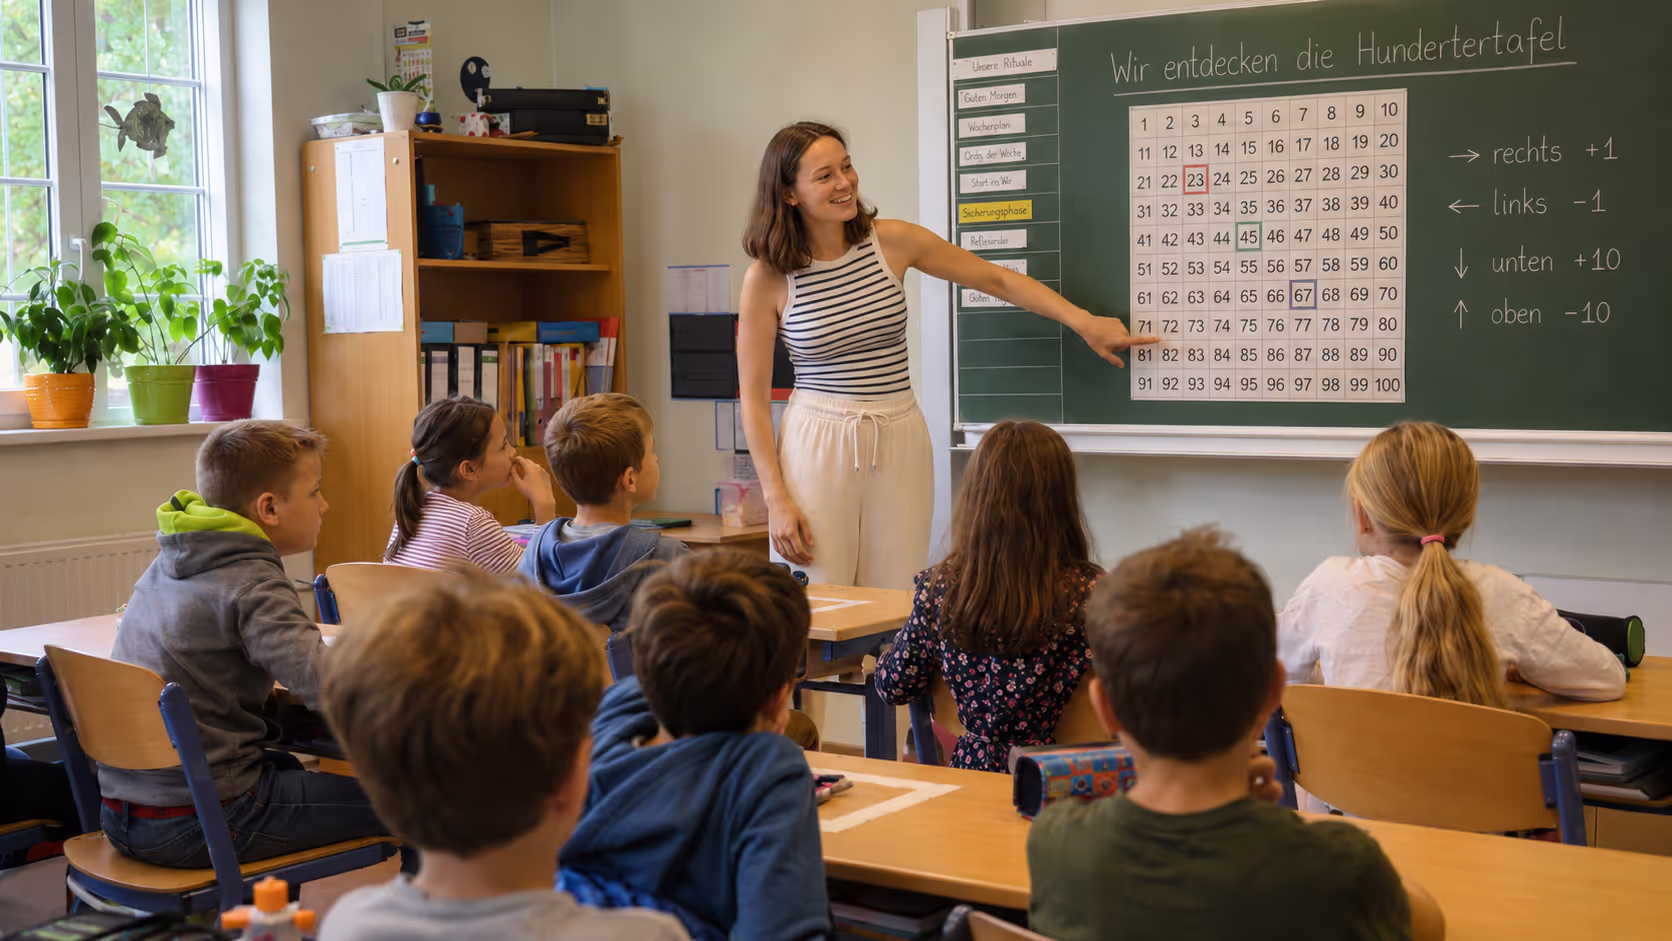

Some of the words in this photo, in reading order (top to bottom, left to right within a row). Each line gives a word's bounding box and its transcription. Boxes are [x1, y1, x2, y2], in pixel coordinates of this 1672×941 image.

[1110, 51, 1150, 83] Wir
[1164, 41, 1278, 80] entdecken
[1297, 37, 1335, 70] die
[1358, 15, 1567, 66] Hundertertafel
[972, 60, 998, 72] Unsere
[1003, 56, 1032, 68] Rituale
[964, 92, 986, 103] Guten
[989, 90, 1017, 103] Morgen
[1141, 118, 1146, 131] 1
[1166, 116, 1174, 130] 2
[1192, 114, 1200, 128] 3
[1217, 113, 1226, 126] 4
[1245, 111, 1253, 125] 5
[1271, 109, 1280, 124] 6
[1299, 107, 1308, 122] 7
[1327, 106, 1336, 120] 8
[1355, 104, 1365, 119] 9
[1381, 102, 1398, 117] 10
[986, 149, 997, 159] der
[1138, 147, 1150, 160] 11
[1163, 145, 1177, 159] 12
[1188, 143, 1203, 158] 13
[1215, 142, 1230, 156] 14
[1241, 140, 1257, 155] 15
[1268, 139, 1284, 154] 16
[1295, 137, 1312, 152] 17
[1323, 136, 1340, 151] 18
[1352, 134, 1368, 149] 19
[1380, 133, 1399, 148] 20
[1494, 135, 1561, 164] rechts
[1586, 137, 1618, 159] +1
[971, 177, 988, 188] Start
[1000, 175, 1012, 185] Wir
[1137, 176, 1151, 190] 21
[1161, 174, 1178, 189] 22
[1187, 173, 1204, 187] 23
[1213, 172, 1231, 186] 24
[1240, 170, 1258, 185] 25
[1267, 169, 1285, 184] 26
[1294, 168, 1312, 183] 27
[1322, 166, 1340, 181] 28
[1350, 165, 1369, 180] 29
[1379, 164, 1398, 179] 30
[962, 203, 1027, 219] Sicherungsphase
[1137, 204, 1151, 219] 31
[1161, 203, 1178, 218] 32
[1187, 202, 1204, 217] 33
[1213, 201, 1231, 216] 34
[1240, 200, 1258, 215] 35
[1267, 199, 1285, 214] 36
[1294, 198, 1312, 213] 37
[1322, 197, 1340, 212] 38
[1350, 196, 1369, 211] 39
[1379, 195, 1398, 209] 40
[1494, 187, 1547, 215] links
[1137, 234, 1151, 247] 41
[1161, 232, 1178, 247] 42
[1187, 232, 1204, 246] 43
[1213, 231, 1231, 245] 44
[1239, 230, 1258, 244] 45
[1266, 229, 1285, 243] 46
[1294, 228, 1312, 243] 47
[1321, 227, 1340, 242] 48
[1350, 226, 1369, 241] 49
[1379, 225, 1398, 240] 50
[1137, 262, 1151, 276] 51
[1162, 262, 1179, 276] 52
[1187, 261, 1205, 275] 53
[1214, 261, 1231, 275] 54
[1240, 260, 1258, 274] 55
[1267, 259, 1285, 273] 56
[1294, 258, 1312, 273] 57
[1322, 257, 1340, 272] 58
[1350, 257, 1369, 272] 59
[1379, 256, 1398, 271] 60
[1493, 245, 1553, 272] unten
[1574, 248, 1620, 270] +10
[1137, 291, 1151, 305] 61
[1162, 290, 1178, 305] 62
[1187, 290, 1205, 304] 63
[1213, 290, 1231, 304] 64
[1240, 289, 1258, 303] 65
[1267, 289, 1285, 303] 66
[1294, 288, 1313, 303] 67
[1322, 287, 1340, 302] 68
[1350, 287, 1369, 301] 69
[1379, 286, 1398, 301] 70
[1491, 298, 1542, 324] oben
[1138, 320, 1152, 333] 71
[1162, 319, 1179, 333] 72
[1188, 319, 1205, 333] 73
[1214, 319, 1231, 332] 74
[1240, 318, 1257, 333] 75
[1267, 318, 1285, 332] 76
[1294, 318, 1312, 332] 77
[1322, 317, 1340, 332] 78
[1350, 317, 1369, 332] 79
[1378, 317, 1397, 332] 80
[1138, 348, 1152, 362] 81
[1162, 348, 1179, 362] 82
[1187, 348, 1205, 362] 83
[1214, 348, 1231, 362] 84
[1240, 348, 1258, 362] 85
[1267, 347, 1285, 362] 86
[1294, 347, 1312, 362] 87
[1321, 347, 1340, 362] 88
[1349, 347, 1368, 362] 89
[1378, 347, 1397, 362] 90
[1138, 377, 1152, 390] 91
[1162, 377, 1179, 391] 92
[1188, 377, 1205, 391] 93
[1214, 377, 1231, 391] 94
[1240, 377, 1258, 391] 95
[1267, 377, 1285, 392] 96
[1294, 377, 1312, 392] 97
[1321, 377, 1340, 392] 98
[1350, 377, 1369, 392] 99
[1375, 377, 1400, 392] 100
